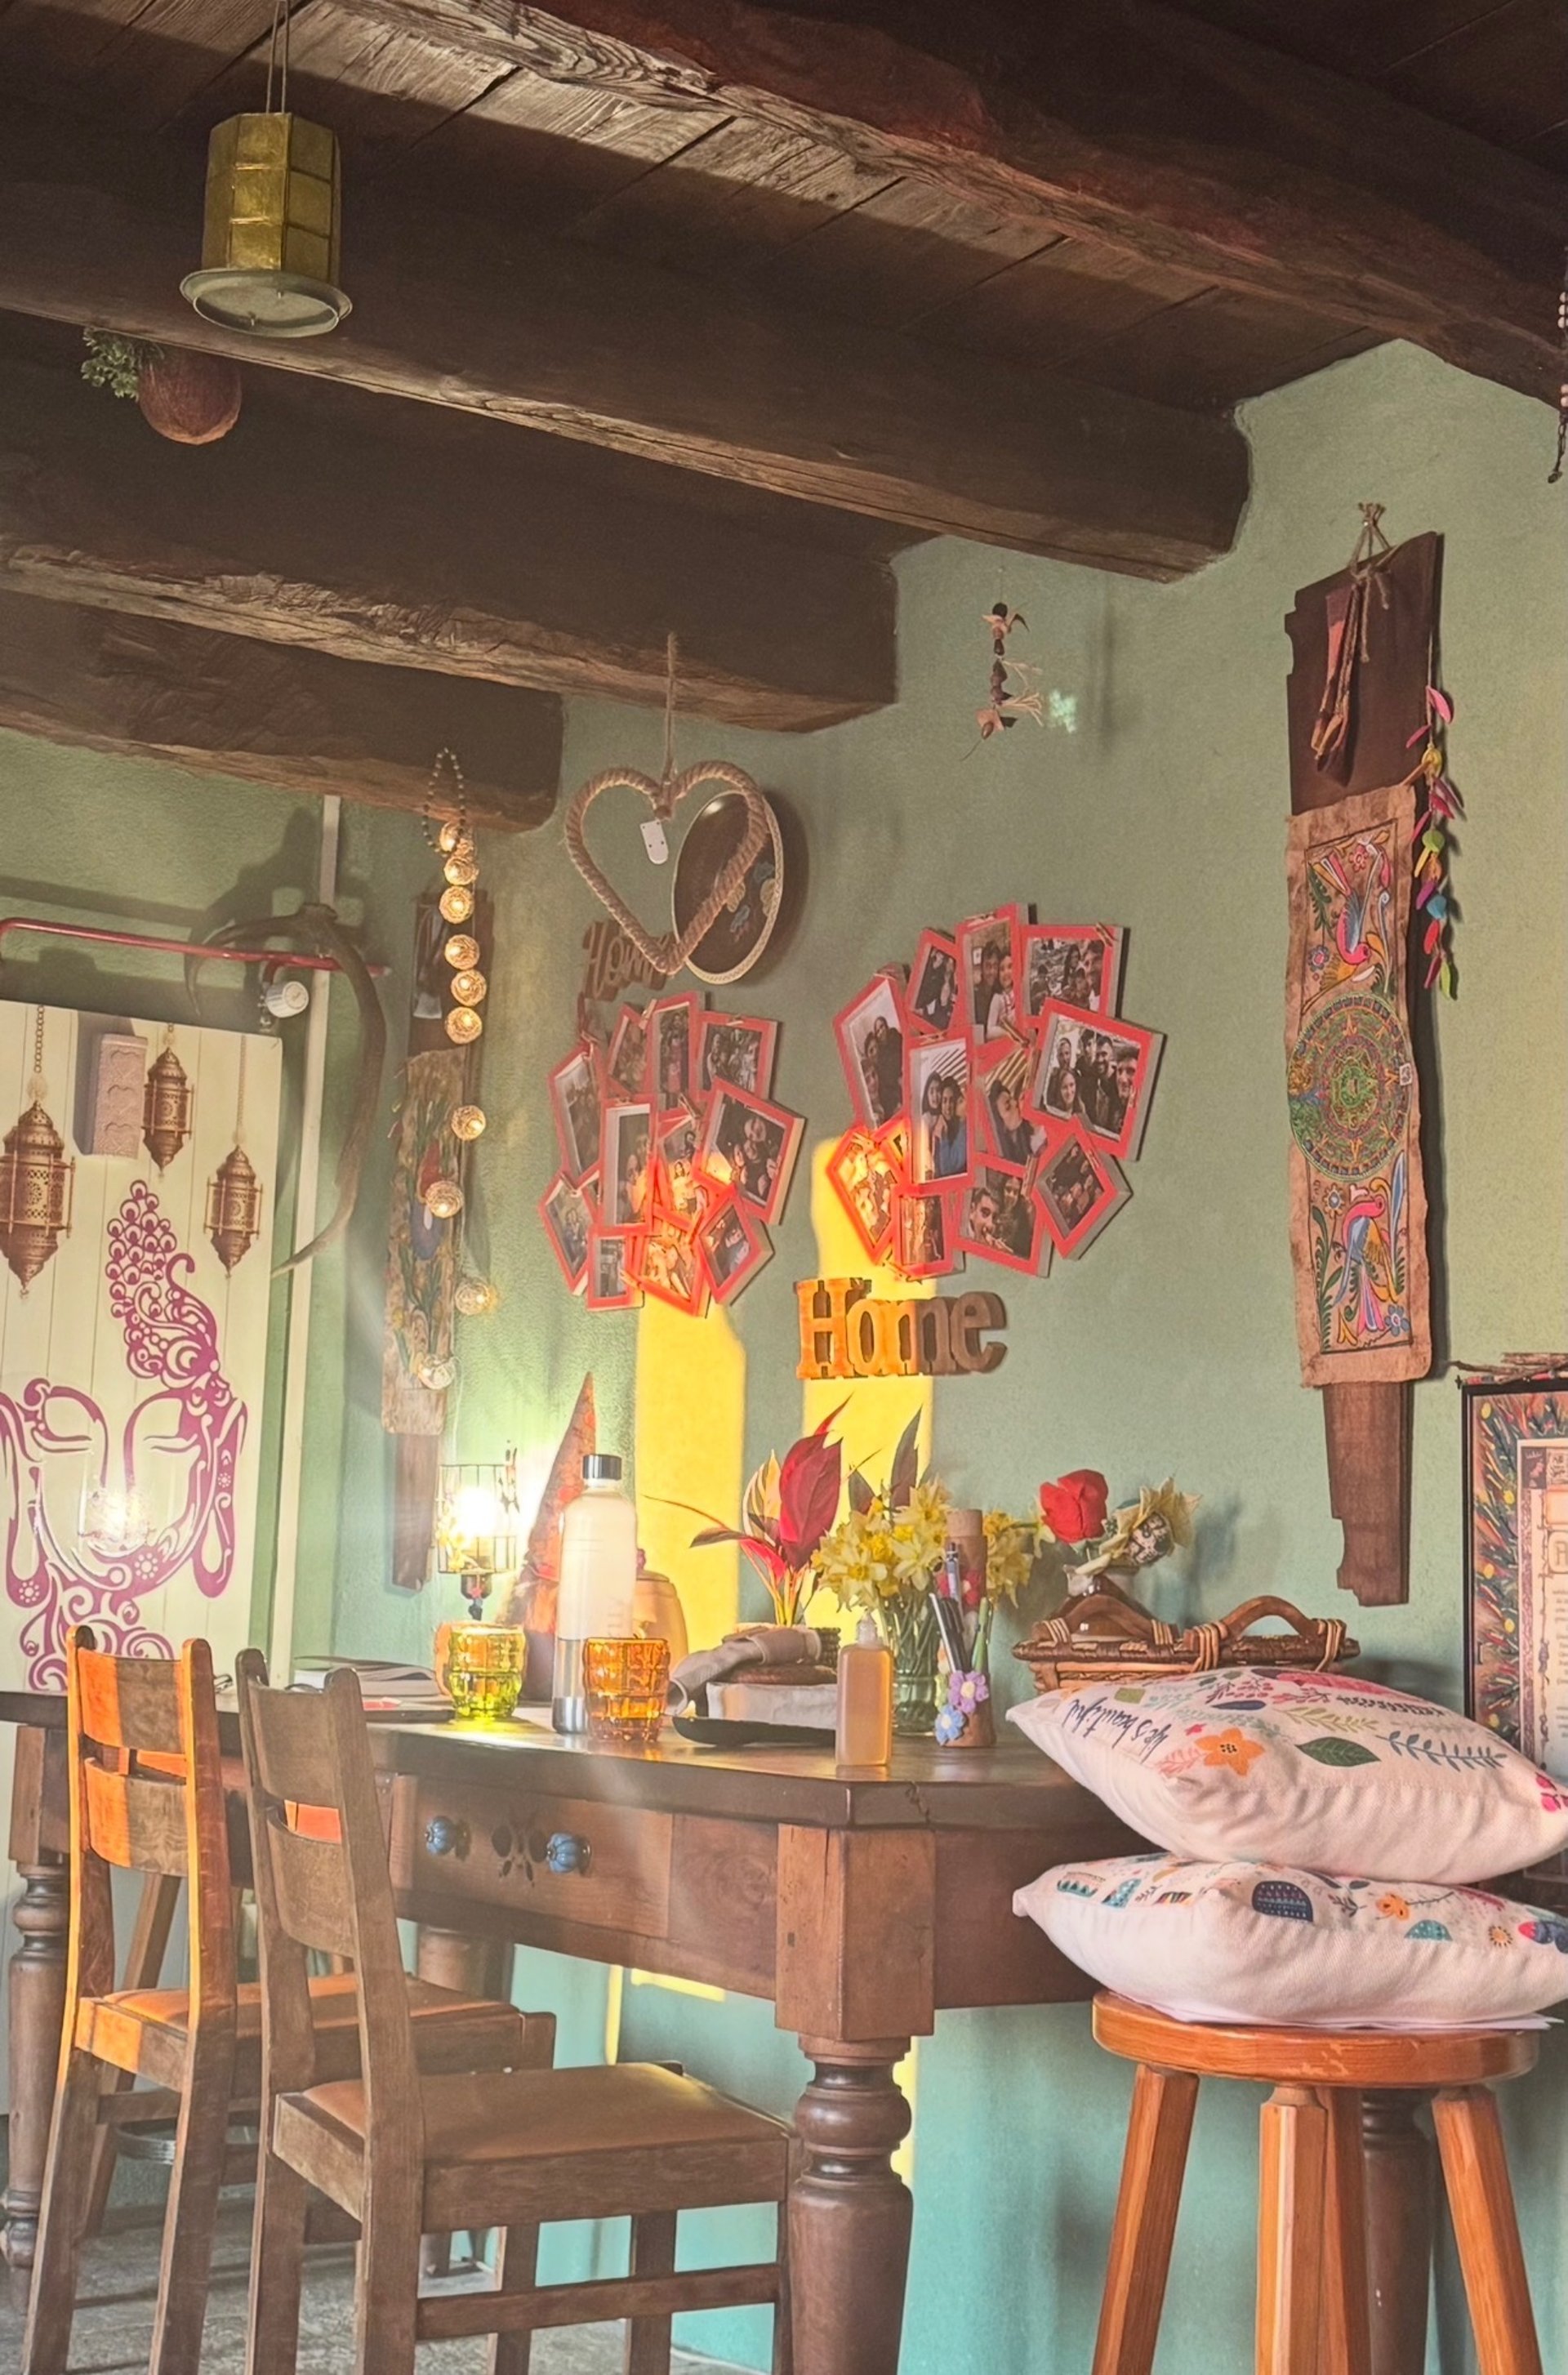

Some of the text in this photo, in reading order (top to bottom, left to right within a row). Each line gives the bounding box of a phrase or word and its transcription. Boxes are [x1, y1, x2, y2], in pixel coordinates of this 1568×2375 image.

[583, 920, 675, 1001] Hom
[793, 1277, 1008, 1379] Home
[1061, 1697, 1138, 1749] beautiful
